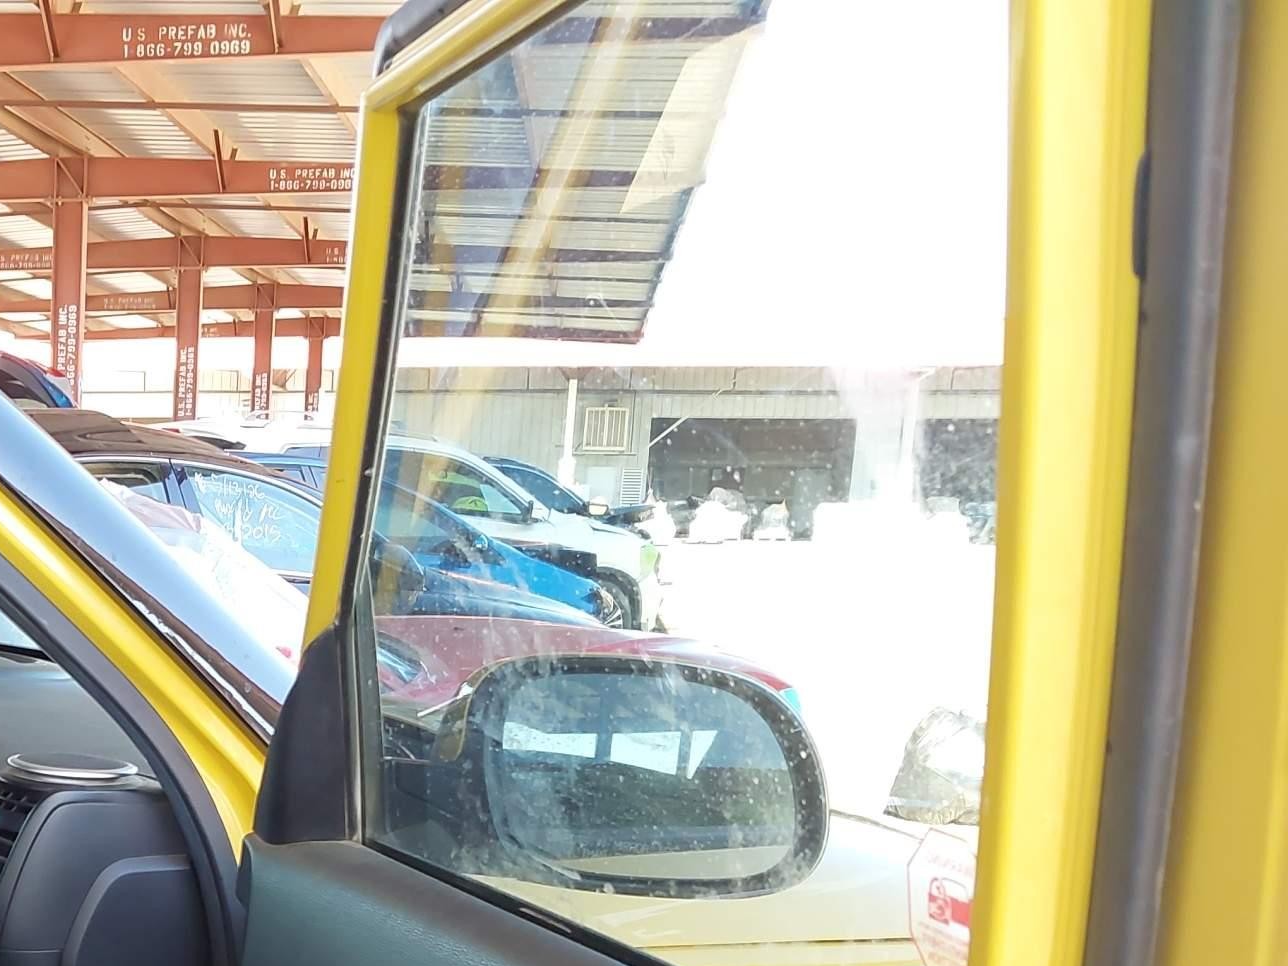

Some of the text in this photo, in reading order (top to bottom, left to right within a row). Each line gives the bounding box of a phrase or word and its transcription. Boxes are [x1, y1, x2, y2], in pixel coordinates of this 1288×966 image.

[158, 24, 216, 40] PREFAB
[224, 23, 252, 39] INC.
[295, 168, 336, 179] PREFAB
[57, 329, 67, 371] PREFAB
